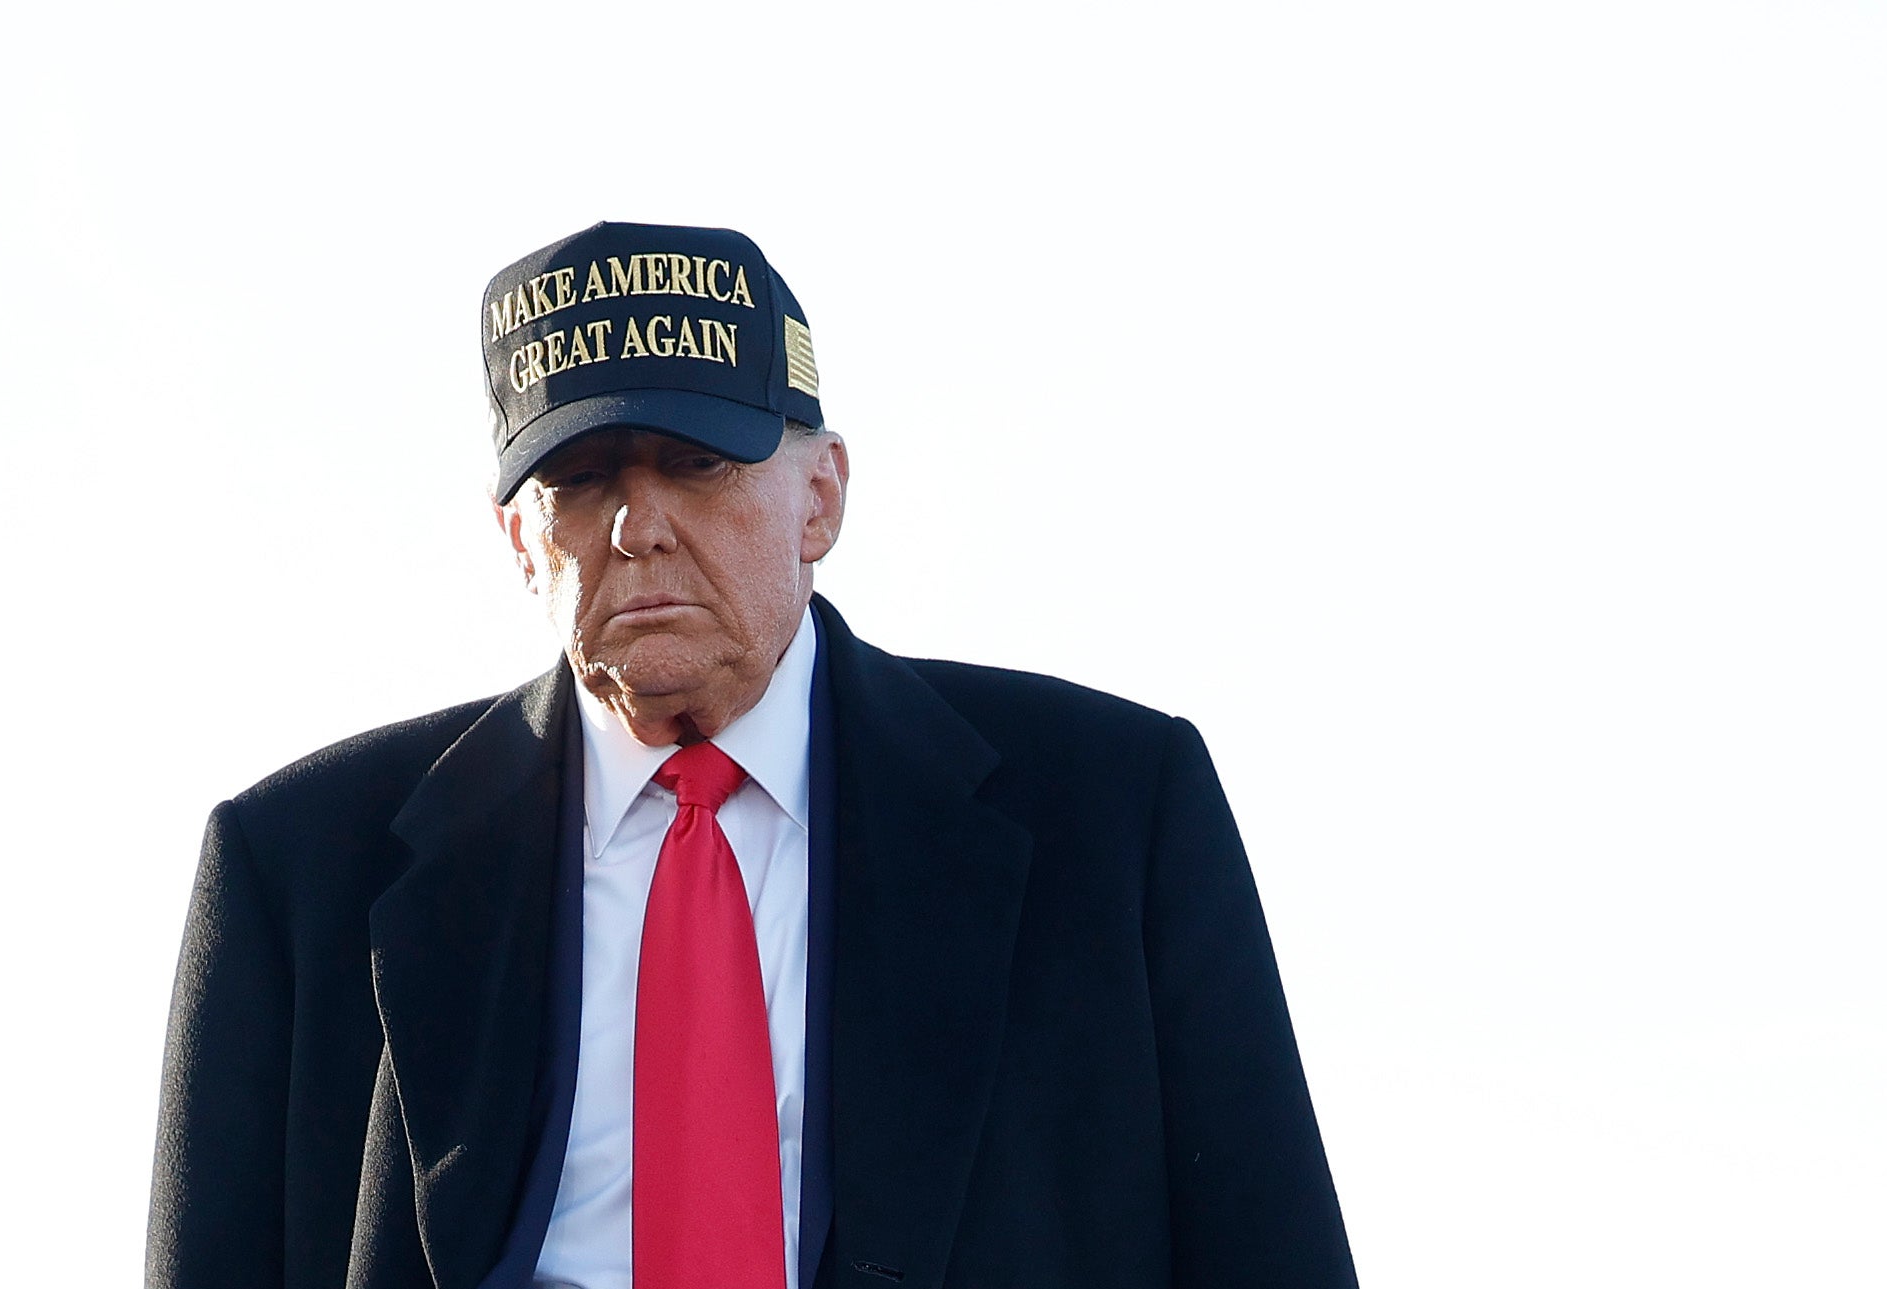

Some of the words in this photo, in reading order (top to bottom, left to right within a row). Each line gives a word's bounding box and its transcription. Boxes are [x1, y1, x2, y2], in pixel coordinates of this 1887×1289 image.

[489, 266, 578, 342] MAKE
[581, 253, 755, 308] AMERICA
[509, 319, 612, 393] GREAT
[619, 315, 738, 367] AGAIN
